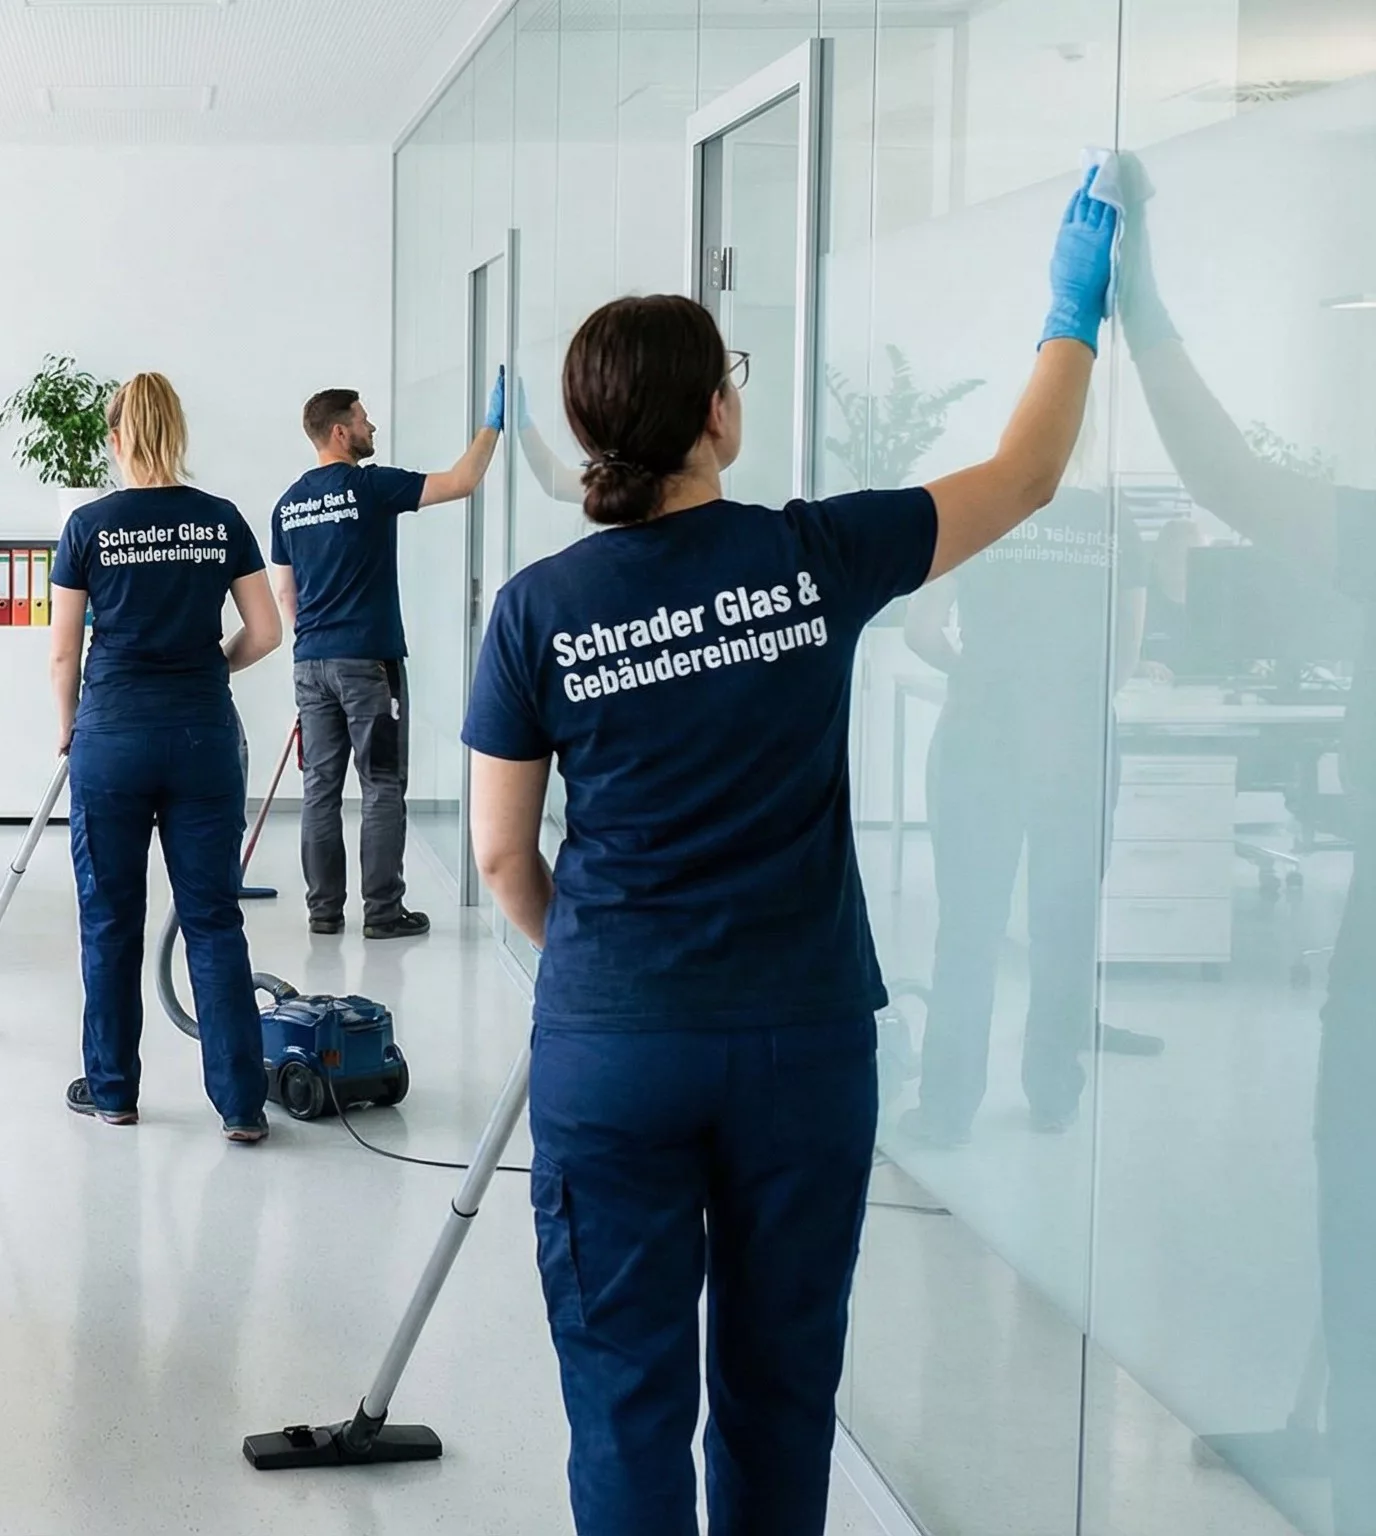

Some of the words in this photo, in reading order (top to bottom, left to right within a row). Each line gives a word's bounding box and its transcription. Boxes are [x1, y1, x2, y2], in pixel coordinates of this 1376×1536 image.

[98, 525, 175, 548] Schrader
[178, 523, 214, 541] Glas
[217, 523, 229, 541] &
[100, 543, 227, 567] Gebäudereinigung
[552, 604, 706, 667] Schrader
[714, 584, 793, 627] Glas
[796, 571, 822, 606] &
[563, 615, 828, 703] Gebäudereinigung
